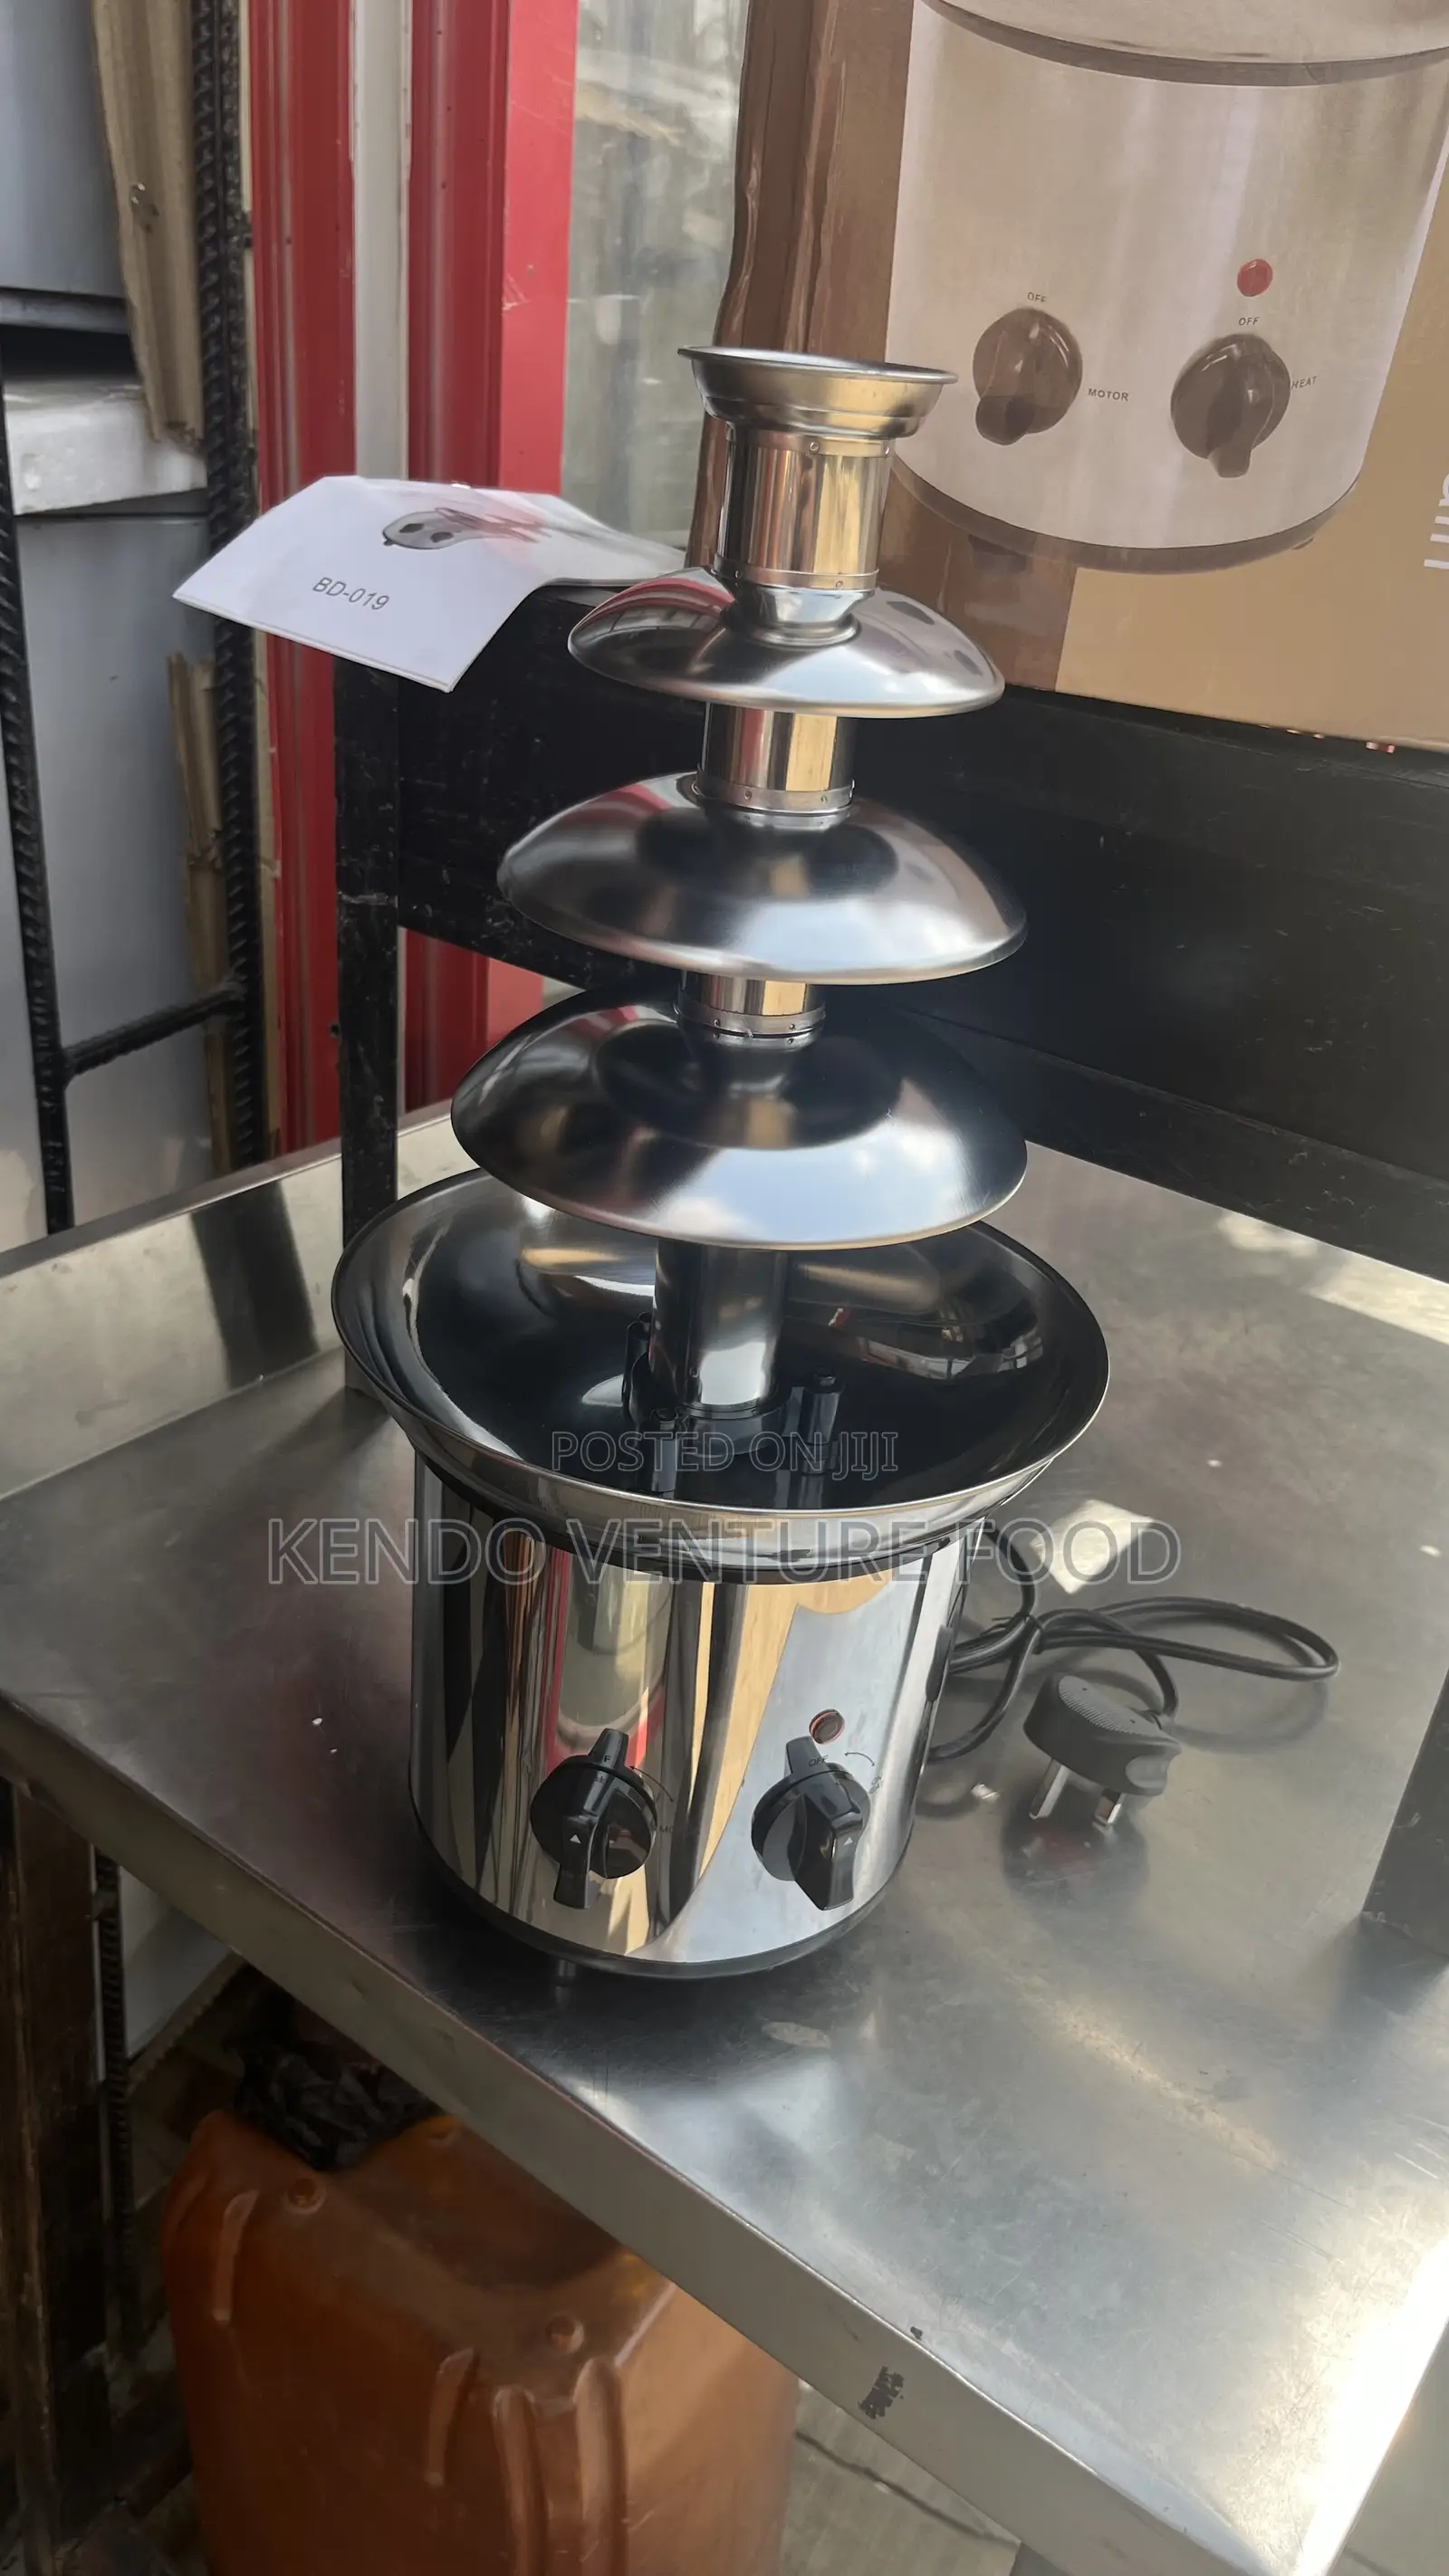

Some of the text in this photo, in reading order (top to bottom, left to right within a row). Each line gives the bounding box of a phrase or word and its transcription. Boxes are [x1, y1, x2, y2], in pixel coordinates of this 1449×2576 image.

[1027, 292, 1047, 302] OFF
[1238, 316, 1261, 326] OFF
[1291, 376, 1318, 389] HEAT
[1088, 388, 1129, 401] MOTOR
[312, 577, 389, 610] BD-019
[808, 1754, 829, 1767] OFF
